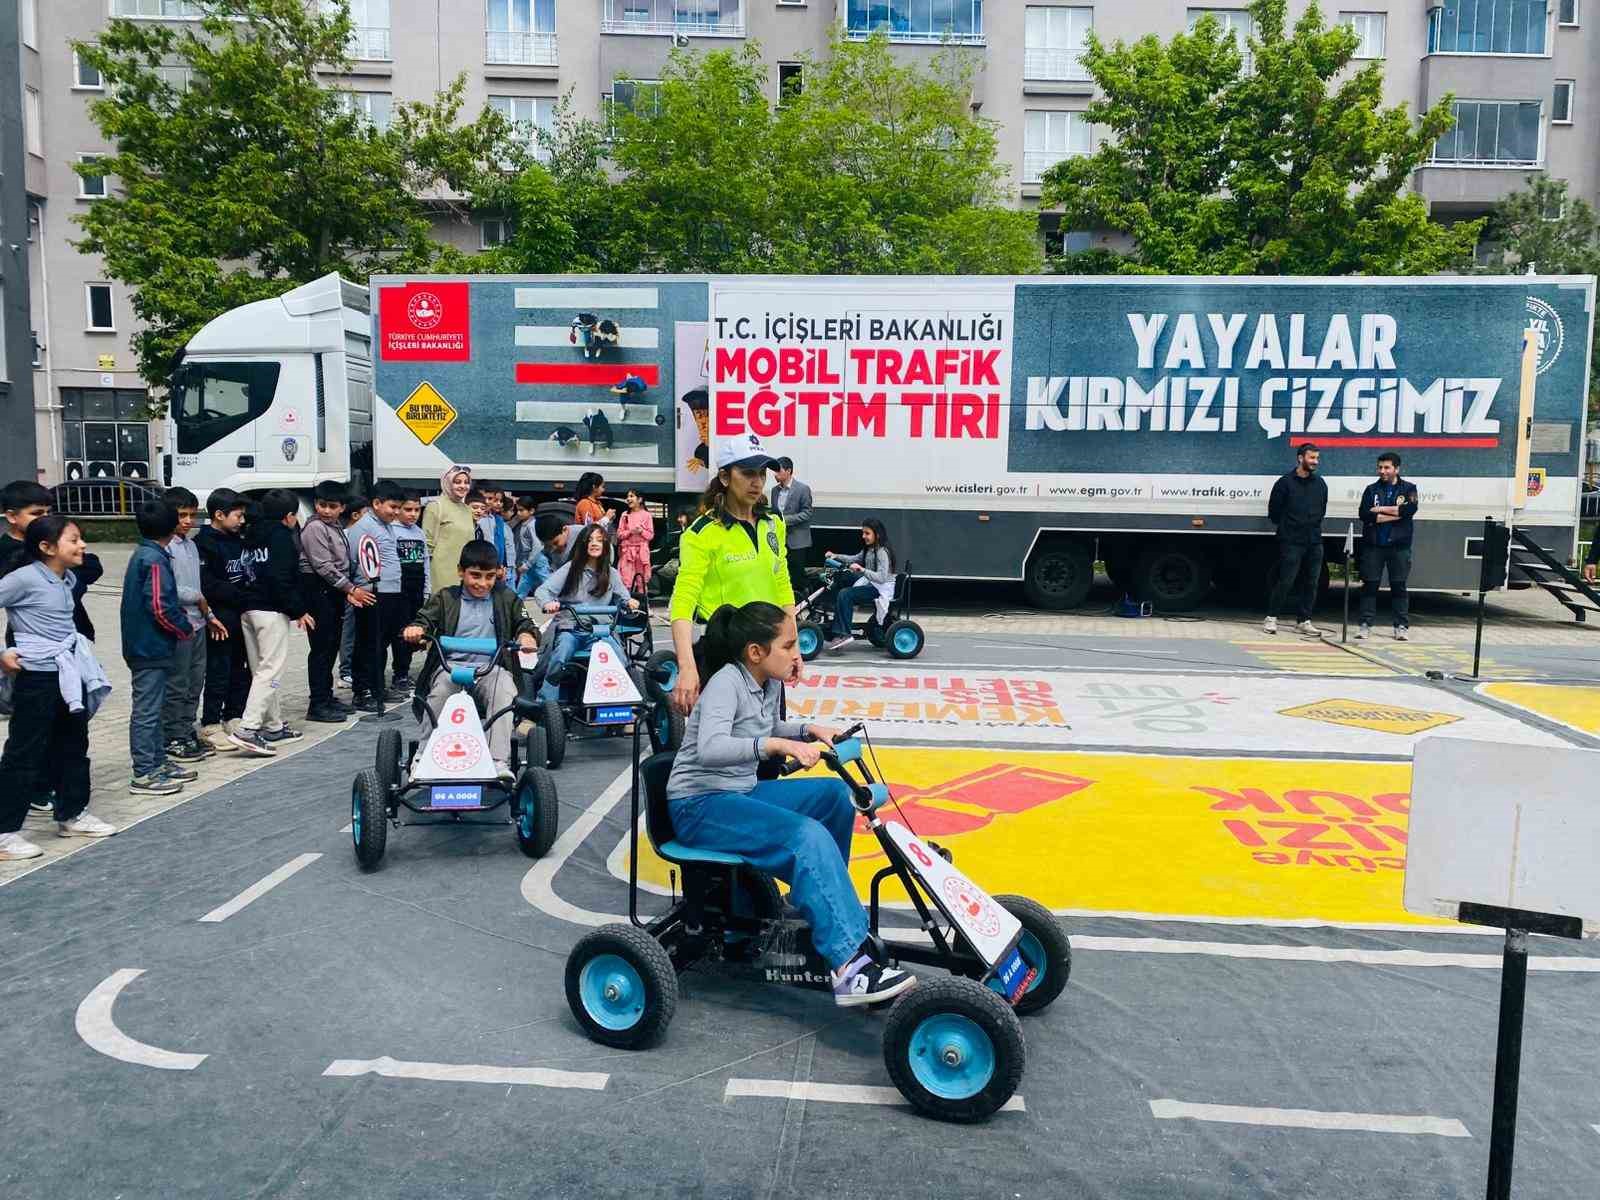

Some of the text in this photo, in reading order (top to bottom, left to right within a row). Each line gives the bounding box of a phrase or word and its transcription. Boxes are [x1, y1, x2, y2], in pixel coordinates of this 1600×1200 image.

[715, 312, 1002, 344] T.C. İÇİŞLERİ BAKANLIĞI
[1127, 313, 1397, 370] YAYALAR
[901, 391, 1000, 439] TIRI
[1025, 377, 1239, 432] KIRMIZI
[925, 479, 1263, 499] www.icisleri.gov.tr www.egm.gov.tr www.trafik.gov.tr
[596, 651, 609, 664] 9
[450, 707, 466, 725] 6
[447, 792, 455, 800] A
[909, 841, 933, 868] 8
[765, 968, 832, 984] Hunter
